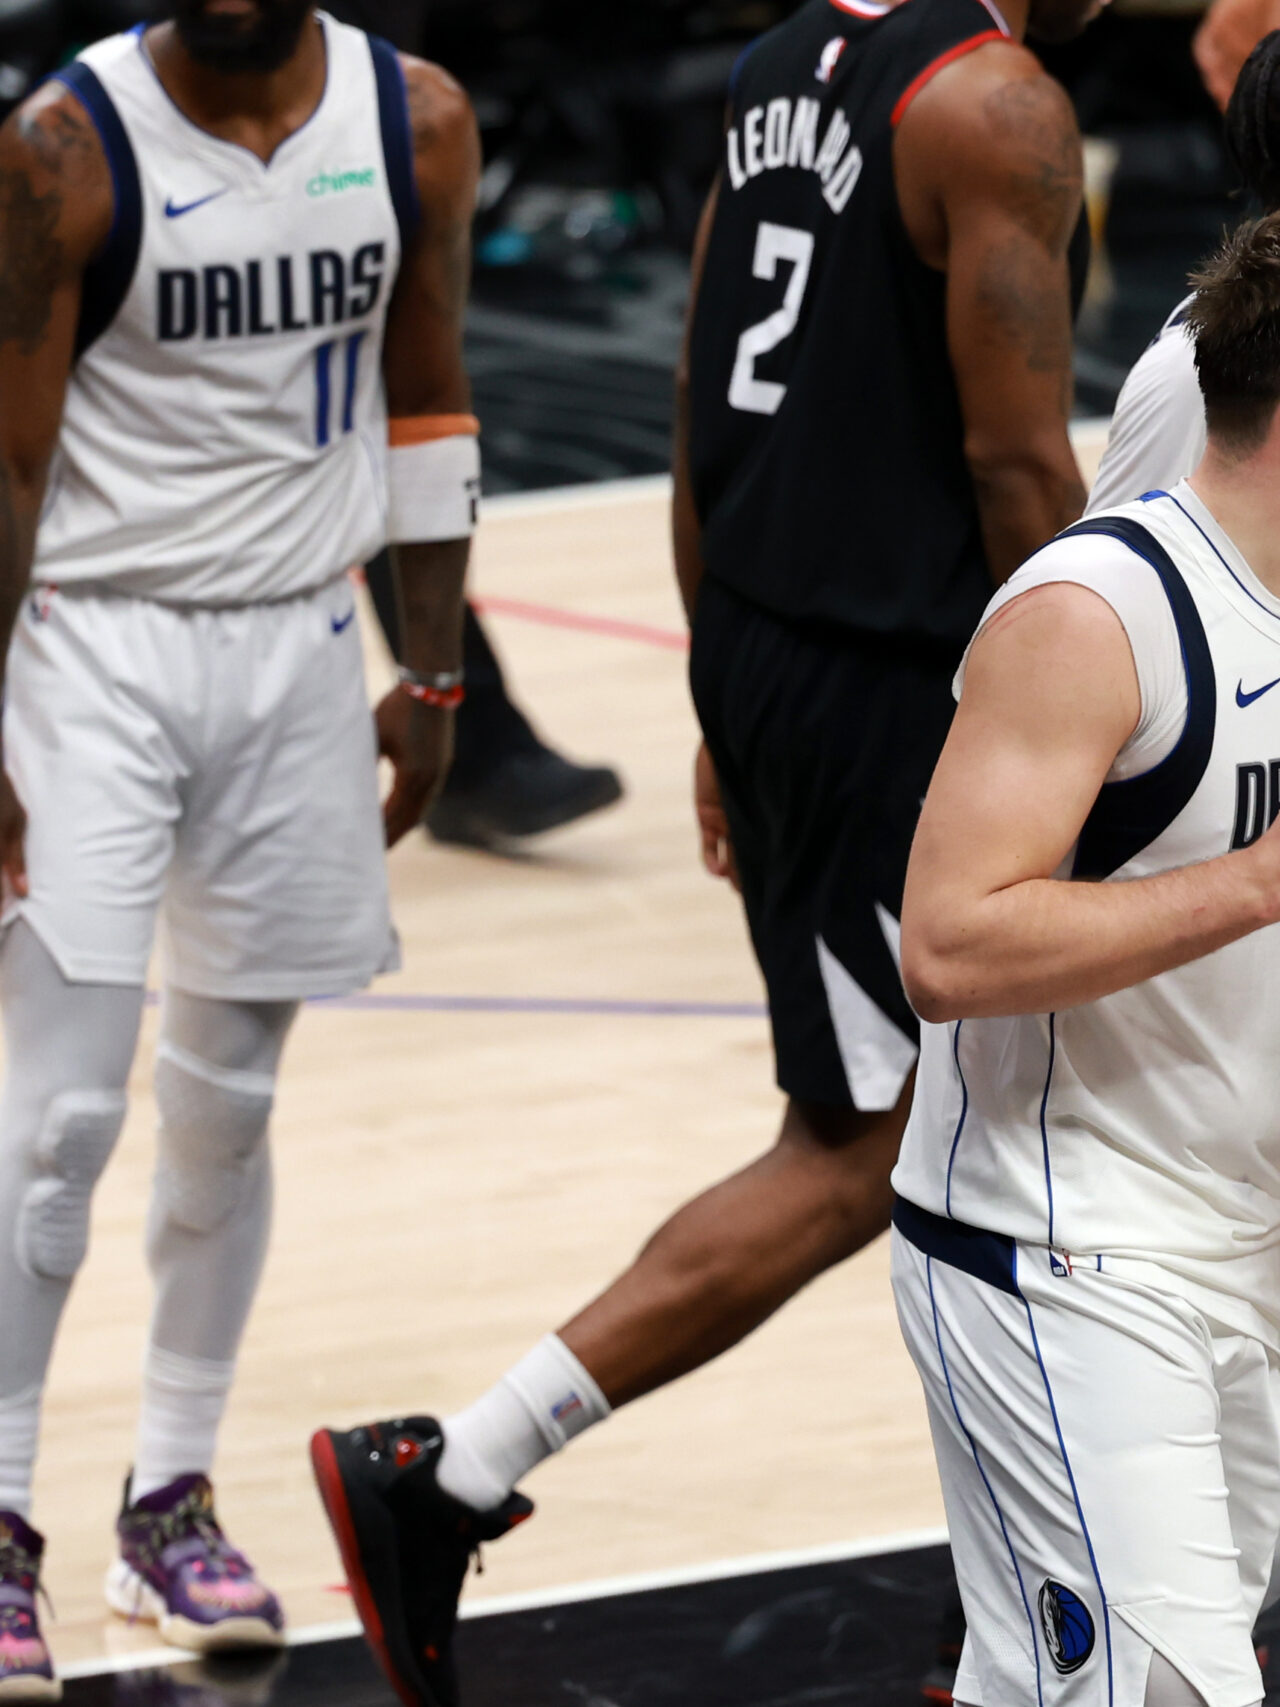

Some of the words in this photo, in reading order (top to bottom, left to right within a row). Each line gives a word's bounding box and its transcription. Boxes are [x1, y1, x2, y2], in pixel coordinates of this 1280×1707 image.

[306, 168, 375, 197] chime
[156, 240, 386, 342] DALLAS
[728, 222, 814, 415] 2
[314, 330, 370, 447] 11
